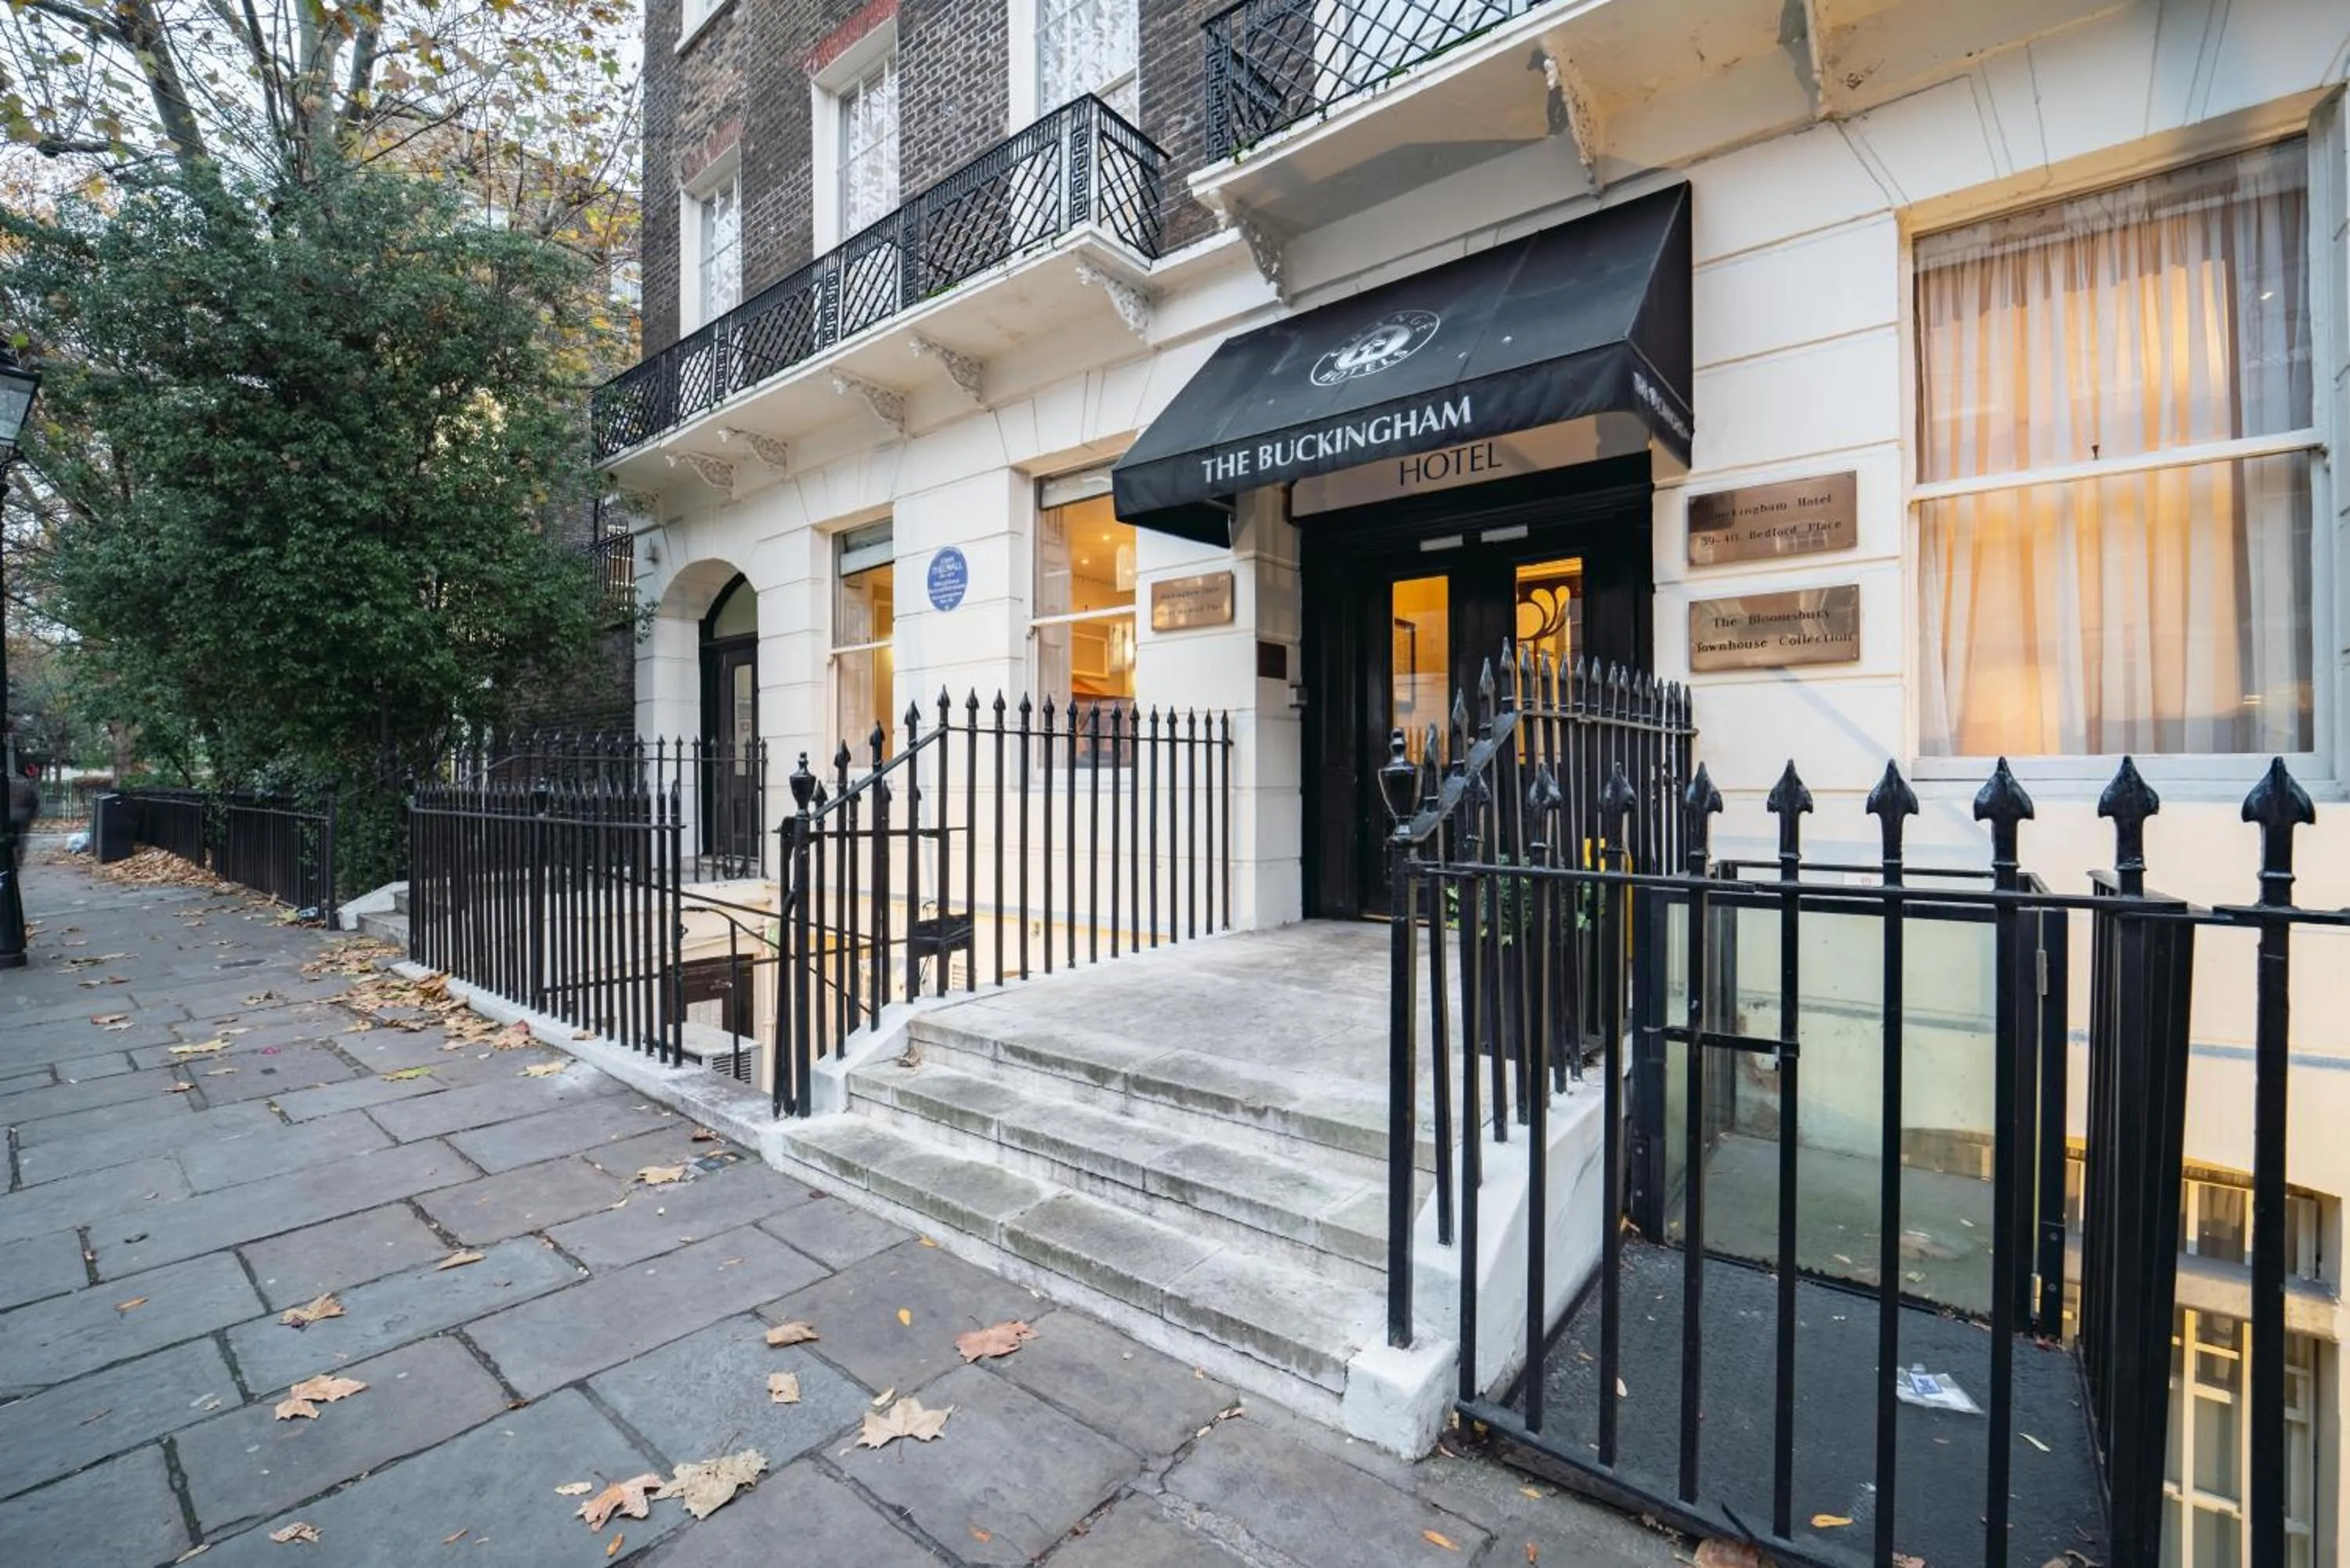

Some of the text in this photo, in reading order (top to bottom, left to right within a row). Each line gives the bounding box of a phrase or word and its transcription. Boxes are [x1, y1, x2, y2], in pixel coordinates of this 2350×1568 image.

[1202, 395, 1473, 484] THE BUCKINGHAM
[1399, 441, 1502, 486] HOTEL
[1798, 493, 1832, 508] Hotel
[1749, 526, 1798, 540] Bedford
[1808, 520, 1842, 533] Place
[1714, 609, 1831, 628] The Bloomsbury
[1696, 632, 1853, 653] Townhouse Collection
